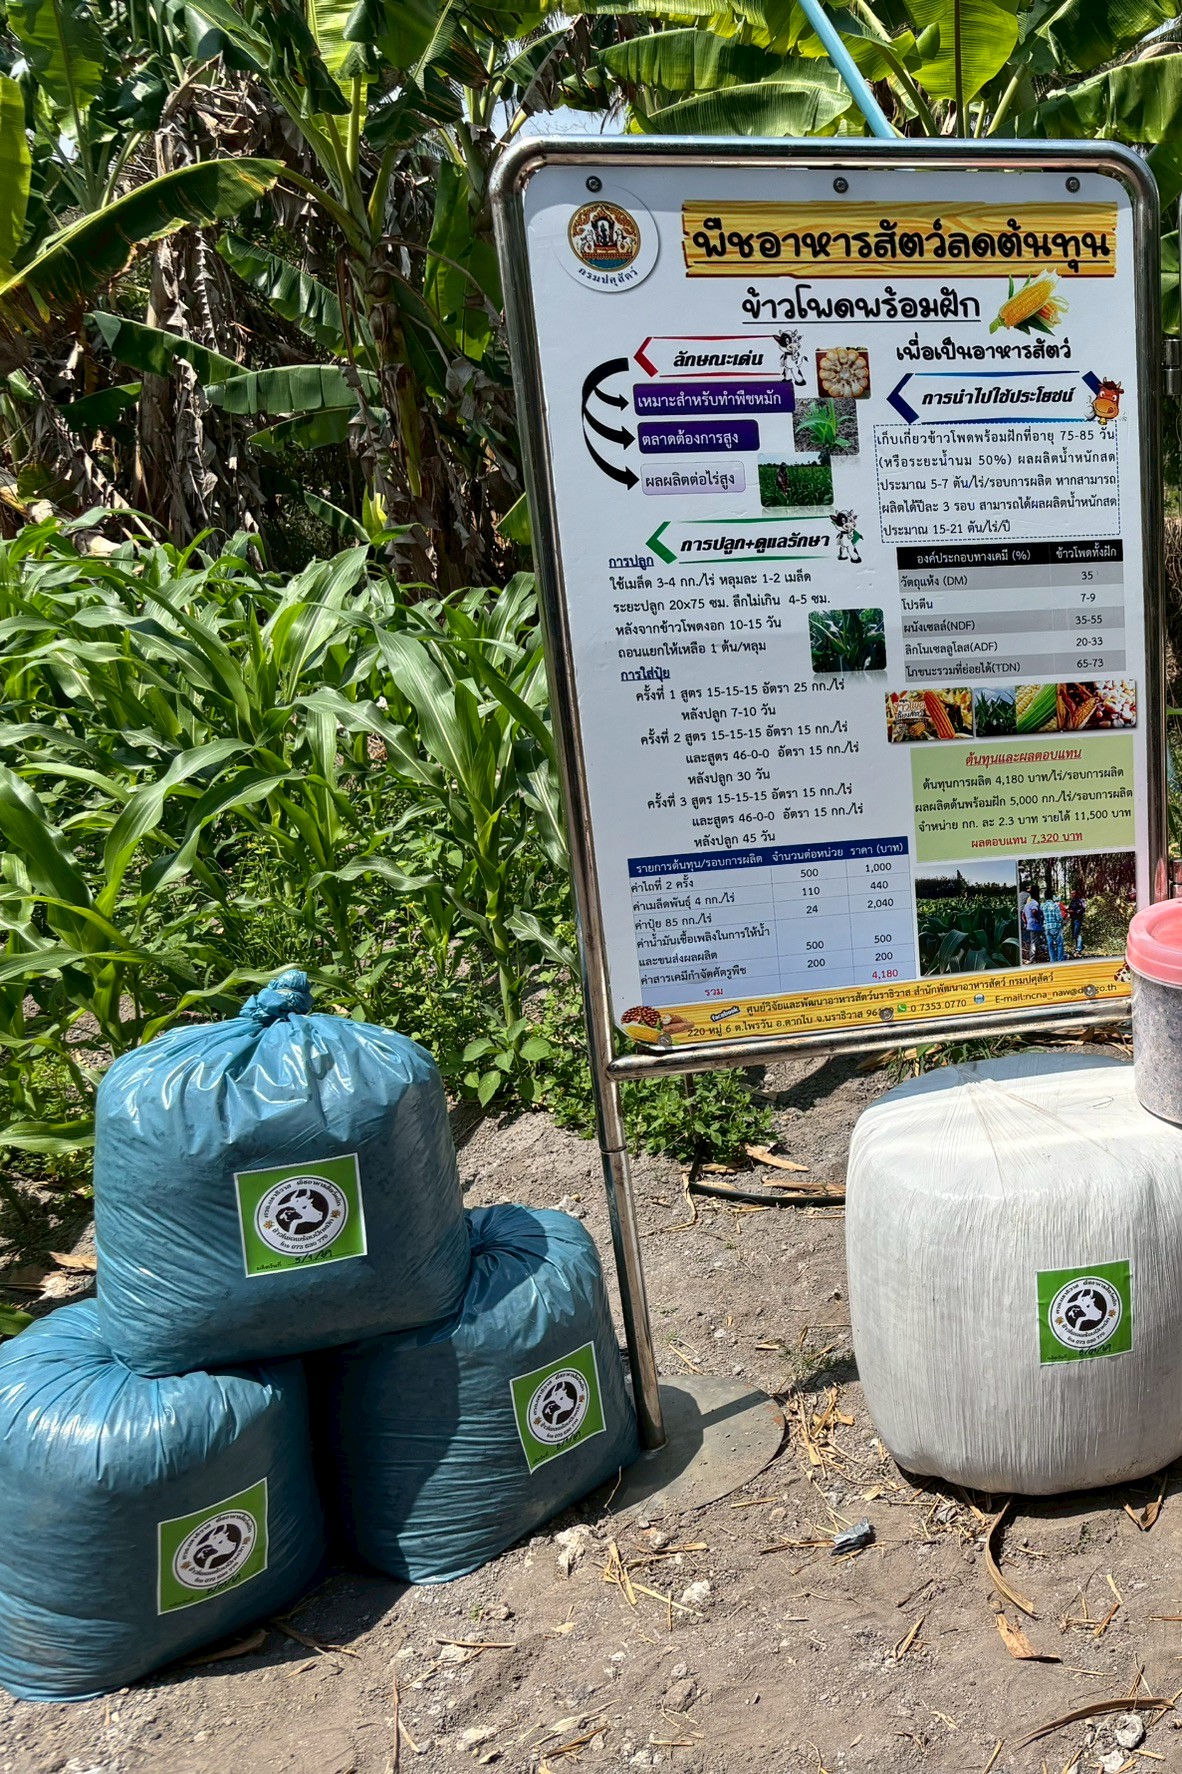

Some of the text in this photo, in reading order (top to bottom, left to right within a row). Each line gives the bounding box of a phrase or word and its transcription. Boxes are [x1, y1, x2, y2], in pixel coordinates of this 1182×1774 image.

[692, 217, 1110, 273] พืชอาหารสัตว์ลดต้นทุน
[578, 266, 639, 287] กรมปศุสัตว์
[742, 284, 981, 319] ข้าวโพดพร้อมฝัก
[896, 332, 1072, 361] เพื่อเป็นอาหารสัตว์
[673, 349, 764, 368] ลักษณะเด่น
[637, 389, 782, 408] เหมาะสำหรับทำพืชหมัก
[921, 386, 1077, 405] การนำไปใช้ประโยชน์
[642, 429, 739, 450] ตลาดต้องการสูง
[877, 427, 1115, 446] เก็บเกี่ยวข้าวโพดพร้อมฝักที่อายุ 75-85 วัน
[878, 447, 1116, 469] (หรือระยะน้ำนม 50%) ผลผลิตน้ำหนักสด
[645, 470, 735, 490] ผลผลิตต่อไร่สูง
[880, 473, 1117, 492] ประมาณ 5-7 ตัน/ไร่/รอบการผลิต หากสามารถ
[881, 492, 1117, 515] ผลิตได้ปีละ รอบ สามารถได้ผลผลิตน้ำหนักสด
[883, 519, 1011, 537] ประมาณ 15-21 ตัน/ไร่/ปี
[680, 532, 831, 555] การปลูก+ดูแลรักษา
[1055, 542, 1118, 559] ข้าวโพดทั้งฝัก
[608, 554, 655, 571] การปลูก
[917, 549, 1031, 565] องค์ประกอบทางเคมี (%)
[609, 569, 812, 592] ใช้เมล็ด 3-4 กก./ไร่ หลุมละ 1-2 เมล็ด
[900, 574, 969, 591] วัตถุแห้ง (DM)
[1080, 570, 1093, 581] 35
[613, 593, 807, 616] ระยะปลูก 20x75 ลึกไม่เกิน 4-5
[901, 597, 933, 611] โปรตีน
[1080, 592, 1096, 603] 7-9
[615, 616, 782, 637] หลังจากข้าวโพดงอก 10-15 วัน
[903, 618, 976, 634] ผนังเซลล์(NDF)
[1074, 614, 1103, 626] 35-55
[618, 639, 767, 659] ถอนแยกให้เหลือ ต้น/หลุม
[905, 641, 998, 658] ลิกโนเซลลูโลส(ADF)
[1076, 636, 1104, 647] 20-33
[1076, 658, 1104, 669] 65-73
[620, 666, 671, 683] การใส่ปุ๋ย
[636, 679, 846, 704] ครั้งที่ สูตร 15-15-15 อัตรา 25 กก./ไร่
[681, 703, 776, 723] หลังปลูก 7-10 วัน
[711, 720, 848, 741] 15-15-15 กก./ไร่
[733, 748, 770, 761] 46-0-0
[965, 748, 1083, 769] ต้นทุนและผลตอบแทน
[923, 767, 1124, 793] ต้นทุนการผลิต 4,180 บาท/ไร่/รอบการผลิต
[915, 787, 1133, 813] ผลผลิตต้นพร้อมฝัก 5,000 กก./ไร่/รอบการผลิต
[918, 808, 1132, 833] จำหน่าย 2.3 บาท รายได้ 11,500 บาท
[971, 830, 1083, 849] ผลตอบแทน 7,320 บาท
[636, 842, 904, 874] รายการต้นทุน/รอบการผลิต จำนวนต่อหน่วย ราคา (บาท)
[800, 862, 892, 878] 500 1,000
[801, 880, 889, 897] 110 440
[665, 898, 894, 928] 85 24 2,040
[636, 922, 770, 949] ค่าน้ำมันเชื้อเพลิงในการให้น้ำ
[638, 933, 892, 967] และขนส่งผลผลิต 500 500
[640, 951, 893, 986] ค่าสารเคมีกำจัดศัตรูพืช 200 200
[871, 968, 899, 980] 4,180
[746, 988, 911, 1016] ศูนย์วิจัยและพัฒนาอาหารสัตว์นราธิวาส
[913, 977, 1006, 997] สำนักพัฒนาอาหารสัตว์
[1009, 972, 1055, 988] กรมปศุสัตว์
[920, 999, 967, 1011] 7353 0770
